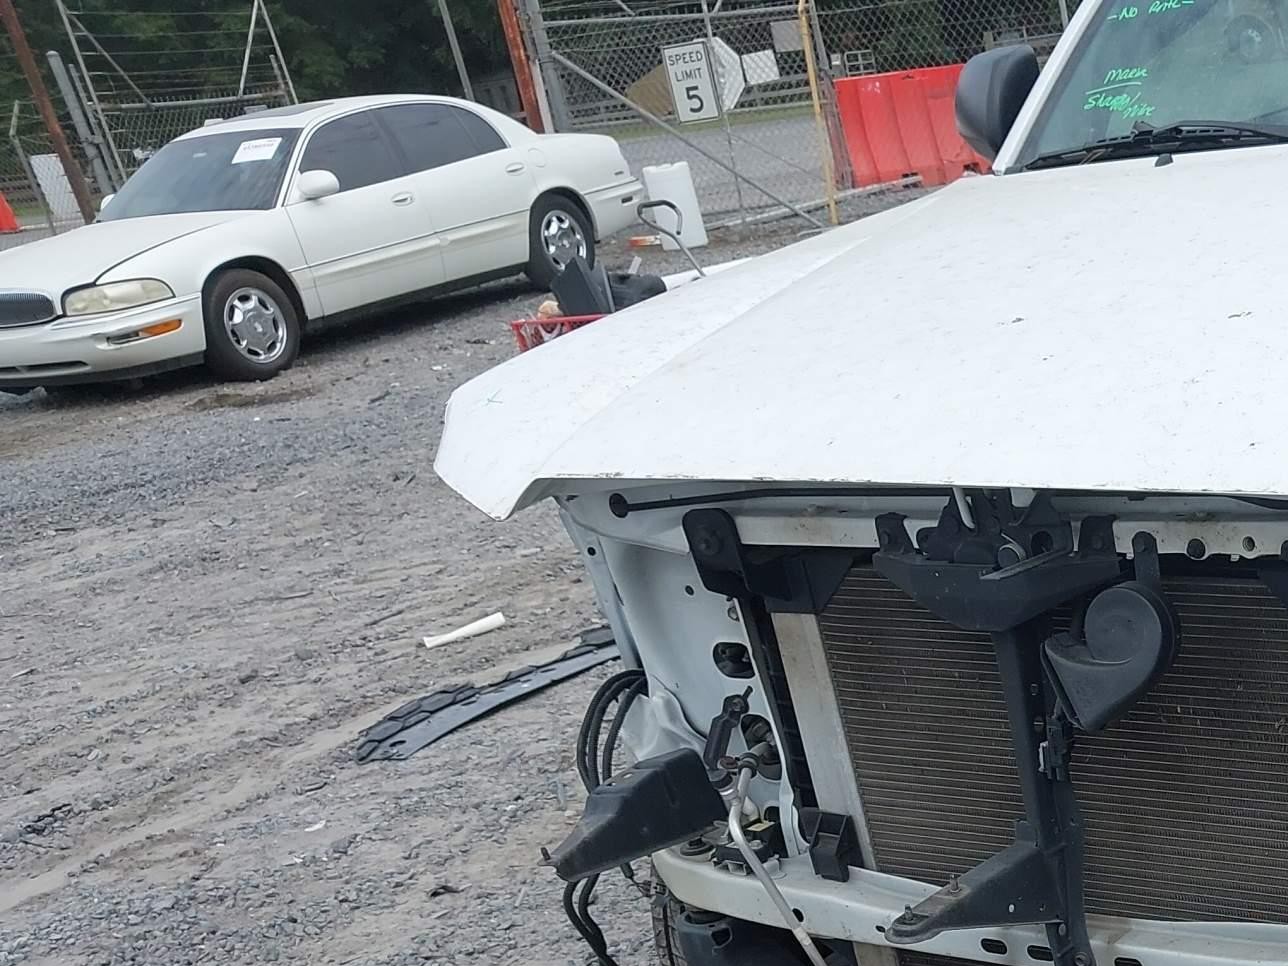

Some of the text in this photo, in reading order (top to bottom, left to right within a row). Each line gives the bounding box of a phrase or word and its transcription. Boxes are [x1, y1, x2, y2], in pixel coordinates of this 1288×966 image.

[668, 51, 703, 66] SPEED
[675, 67, 702, 82] LIMIT
[685, 85, 704, 113] 5
